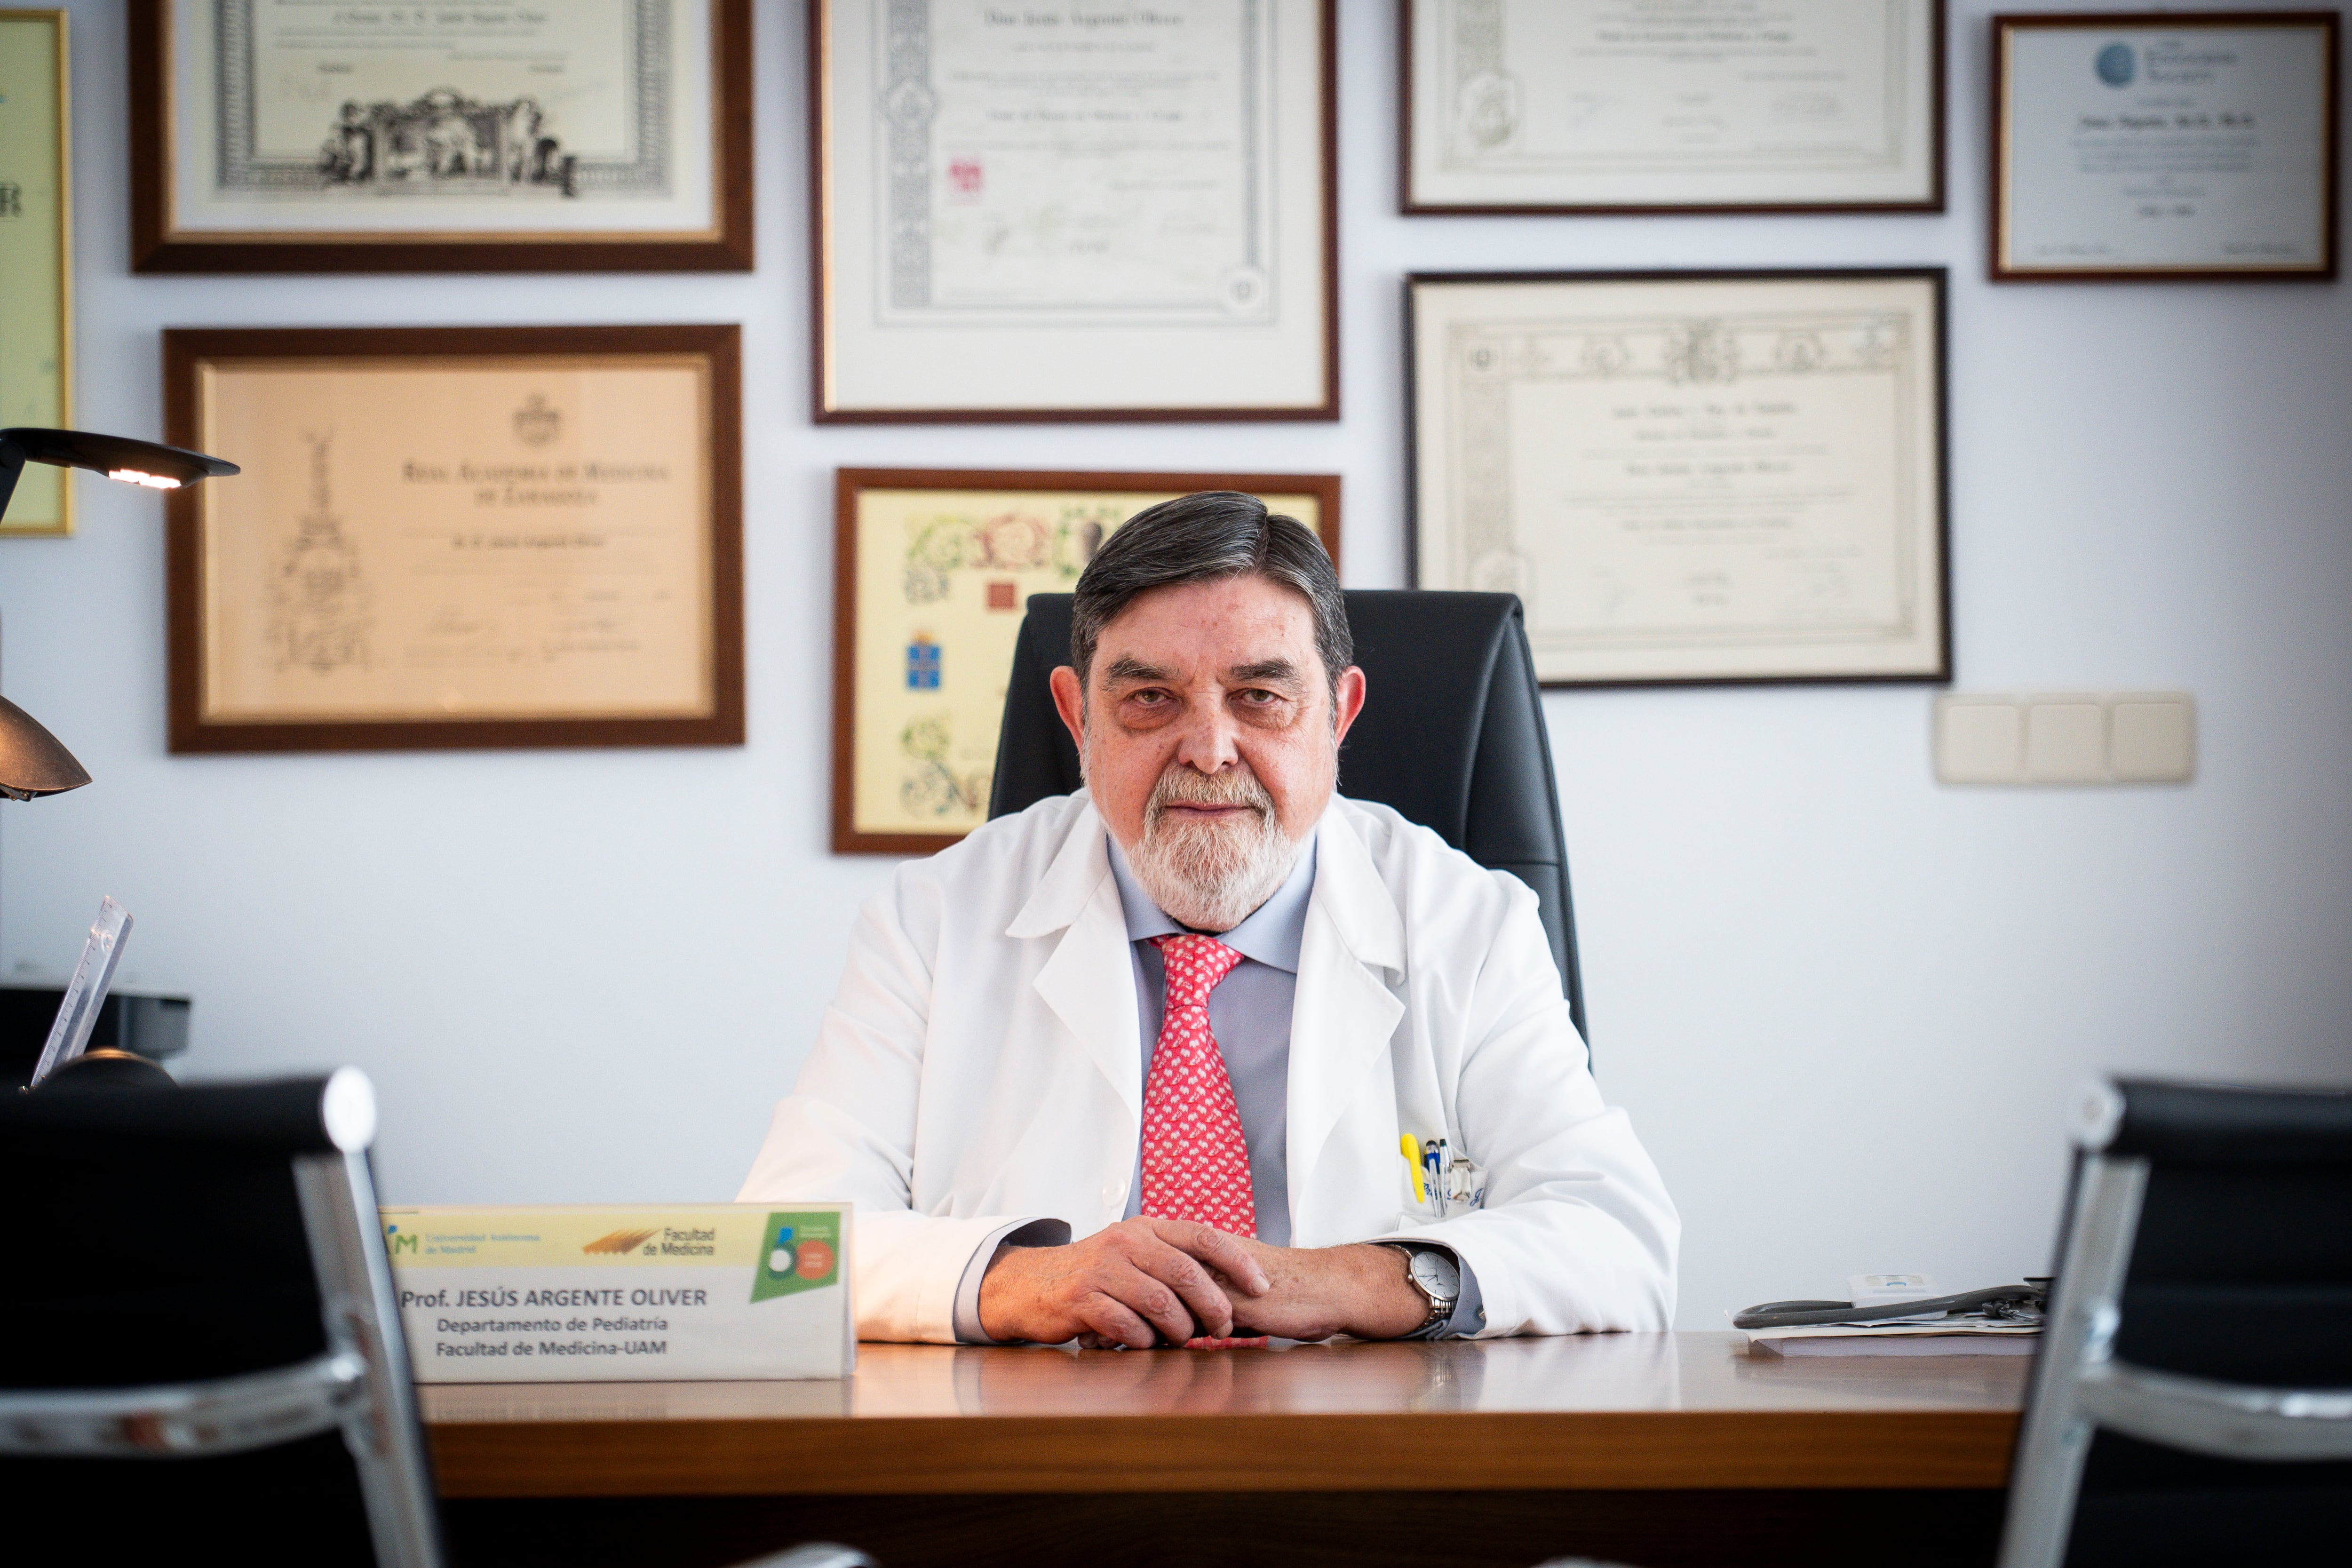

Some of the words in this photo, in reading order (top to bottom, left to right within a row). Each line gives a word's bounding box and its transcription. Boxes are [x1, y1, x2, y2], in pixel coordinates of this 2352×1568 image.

[664, 1227, 715, 1241] Facultad
[643, 1242, 657, 1256] de
[661, 1242, 715, 1256] Medicina
[401, 1289, 450, 1307] Prof.
[456, 1286, 518, 1307] JESÚS
[524, 1289, 625, 1306] ARGENTE
[630, 1289, 708, 1306] OLIVER
[437, 1318, 562, 1335] Departamento
[566, 1317, 588, 1331] de
[592, 1317, 668, 1331] Pediatría
[436, 1341, 508, 1356] Facultad
[513, 1341, 534, 1356] de
[539, 1341, 667, 1355] Medicina-UAM
